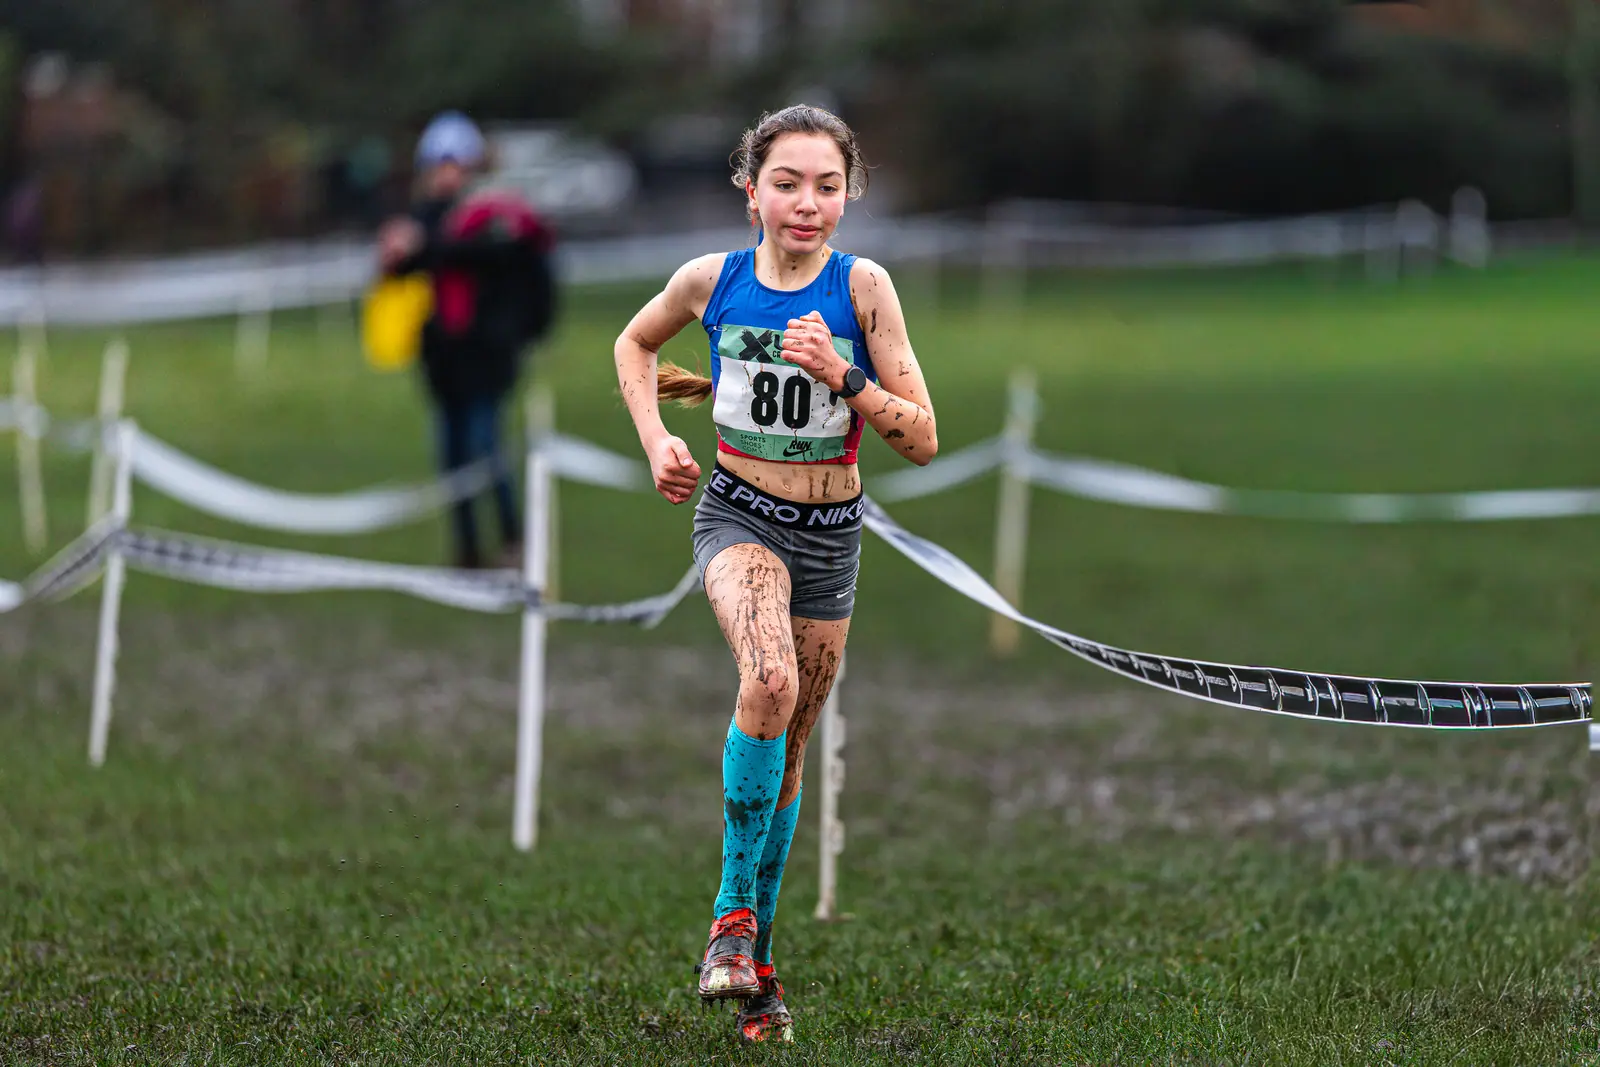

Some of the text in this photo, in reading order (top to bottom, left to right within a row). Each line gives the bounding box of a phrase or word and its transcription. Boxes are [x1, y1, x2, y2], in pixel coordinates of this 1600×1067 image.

[740, 433, 766, 443] SPORTS
[740, 440, 762, 449] SHOES
[730, 485, 800, 523] PRO
[807, 498, 864, 526] NIKE
